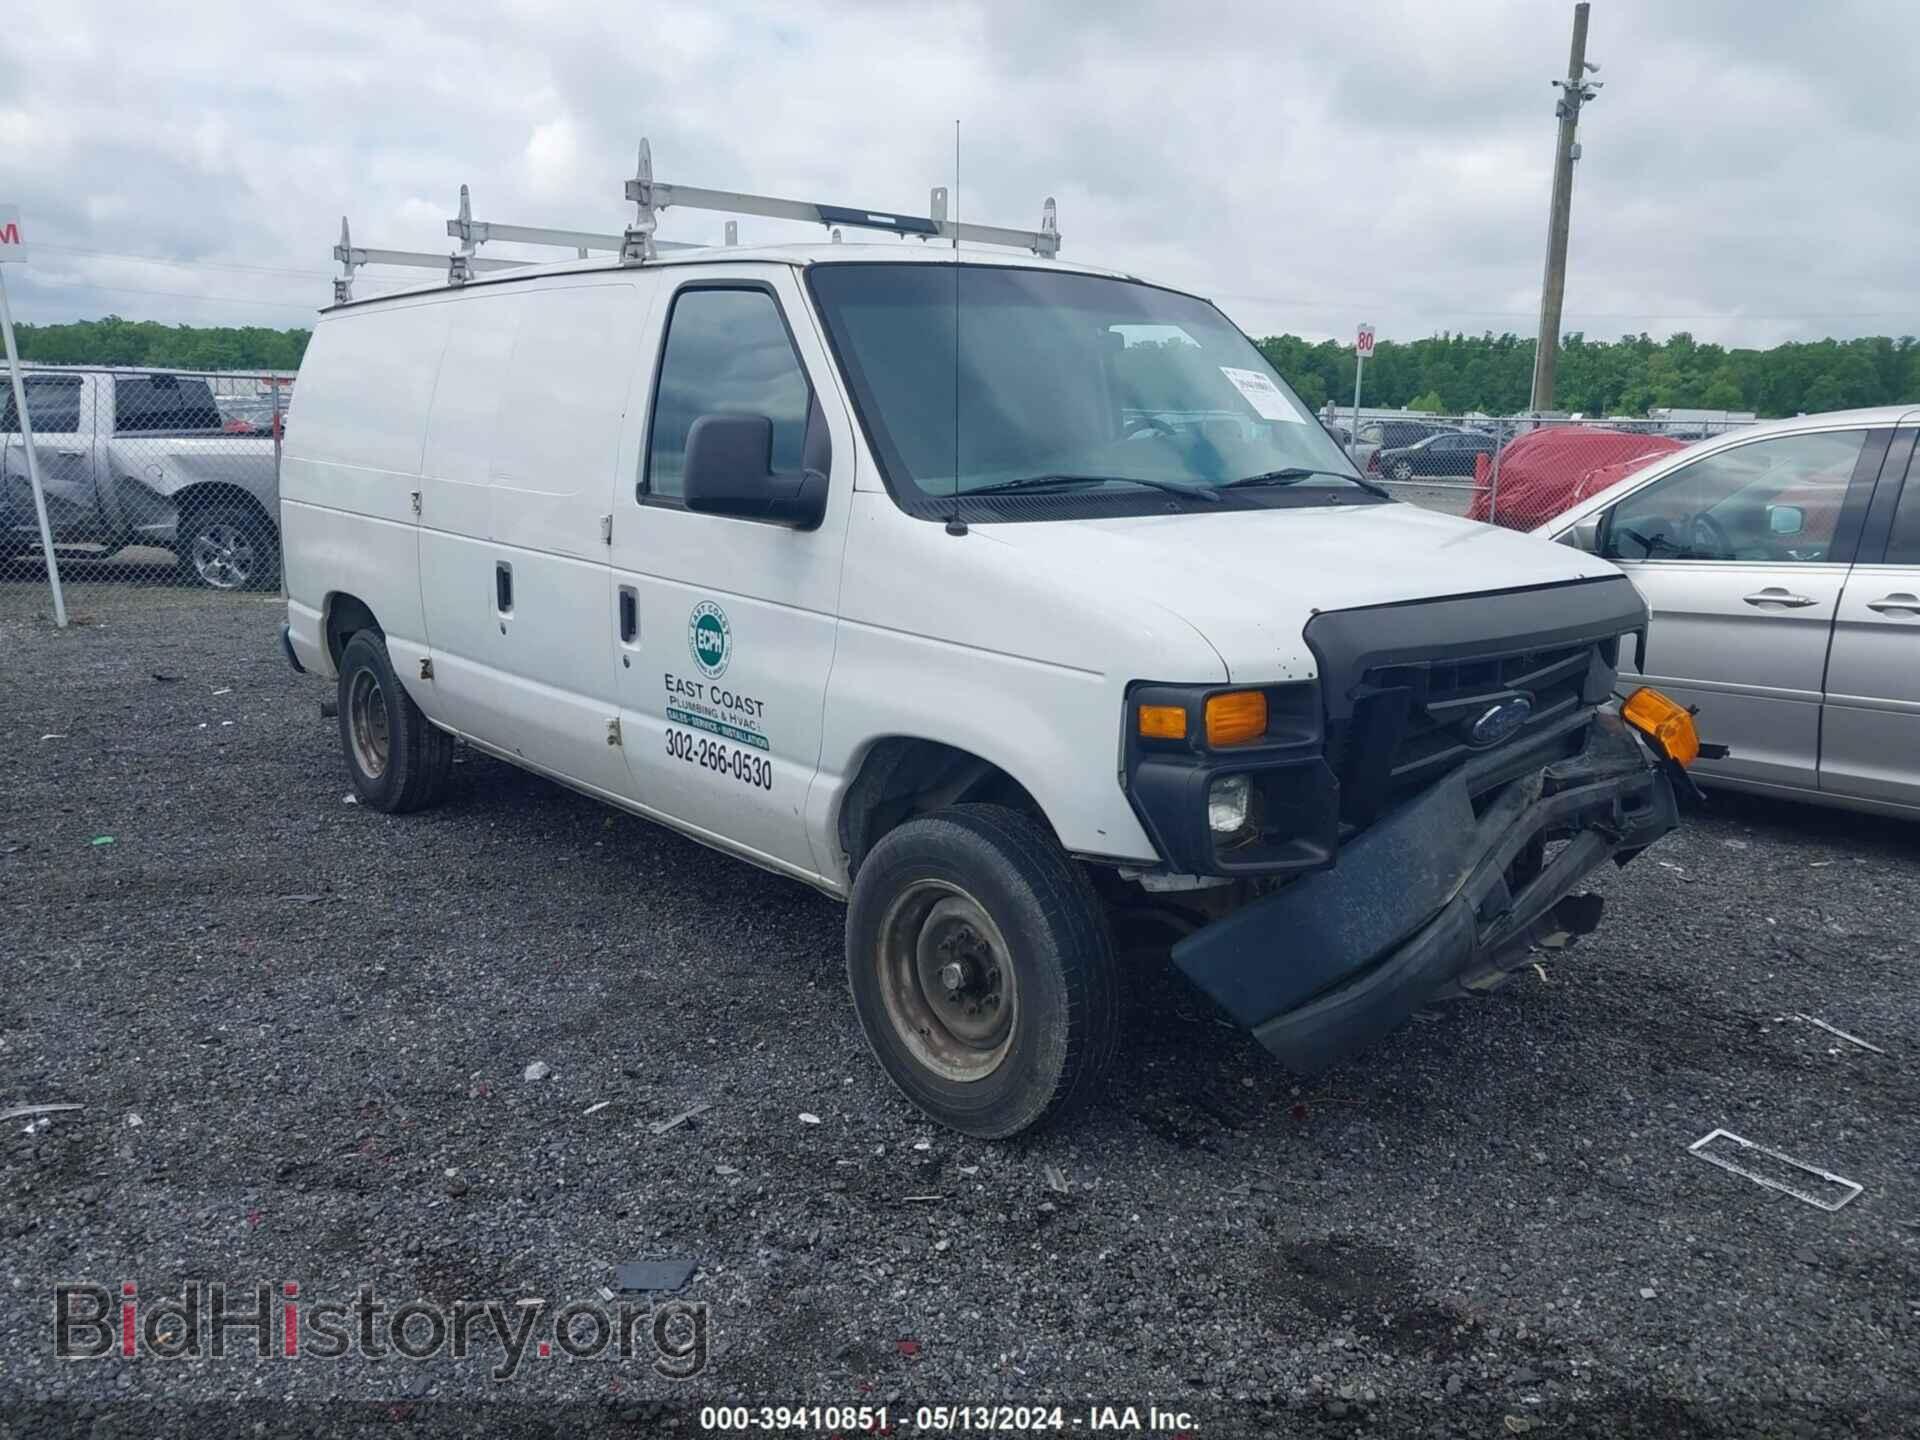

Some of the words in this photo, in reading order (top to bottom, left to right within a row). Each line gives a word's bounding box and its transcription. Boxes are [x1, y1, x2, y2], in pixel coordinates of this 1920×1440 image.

[1358, 331, 1373, 351] 80
[690, 604, 705, 629] EAST
[697, 627, 722, 654] ECPH
[664, 672, 704, 700] EAST
[710, 685, 764, 718] COAST
[669, 695, 718, 719] PLUMBING
[721, 711, 728, 721] &
[665, 727, 772, 791] 302-266-0530
